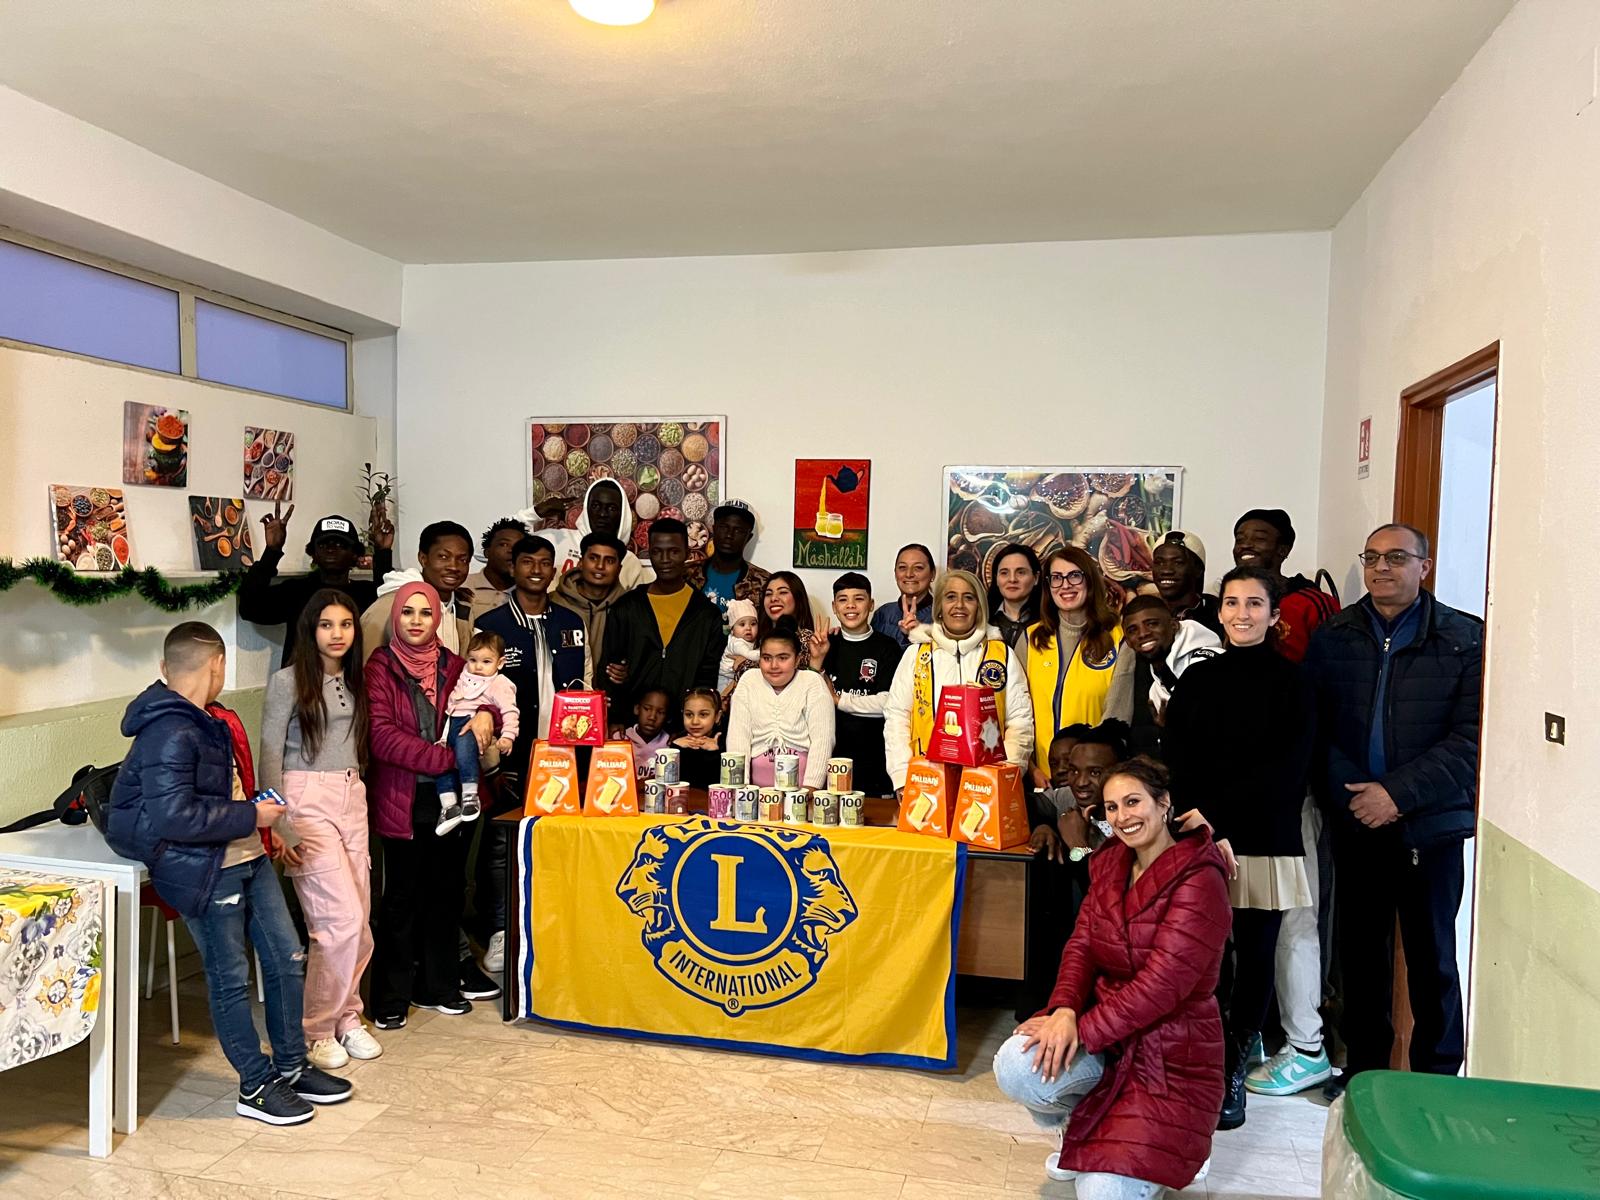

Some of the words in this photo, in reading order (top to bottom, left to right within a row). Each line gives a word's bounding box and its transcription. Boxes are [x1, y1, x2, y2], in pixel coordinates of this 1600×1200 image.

[776, 761, 785, 772] 5
[827, 763, 848, 774] 200
[644, 784, 659, 796] 20
[712, 790, 733, 800] 500
[738, 791, 755, 802] 20
[759, 793, 780, 804] 200
[841, 797, 862, 808] 100
[709, 853, 768, 935] L
[669, 949, 802, 998] INTERNATIONAL
